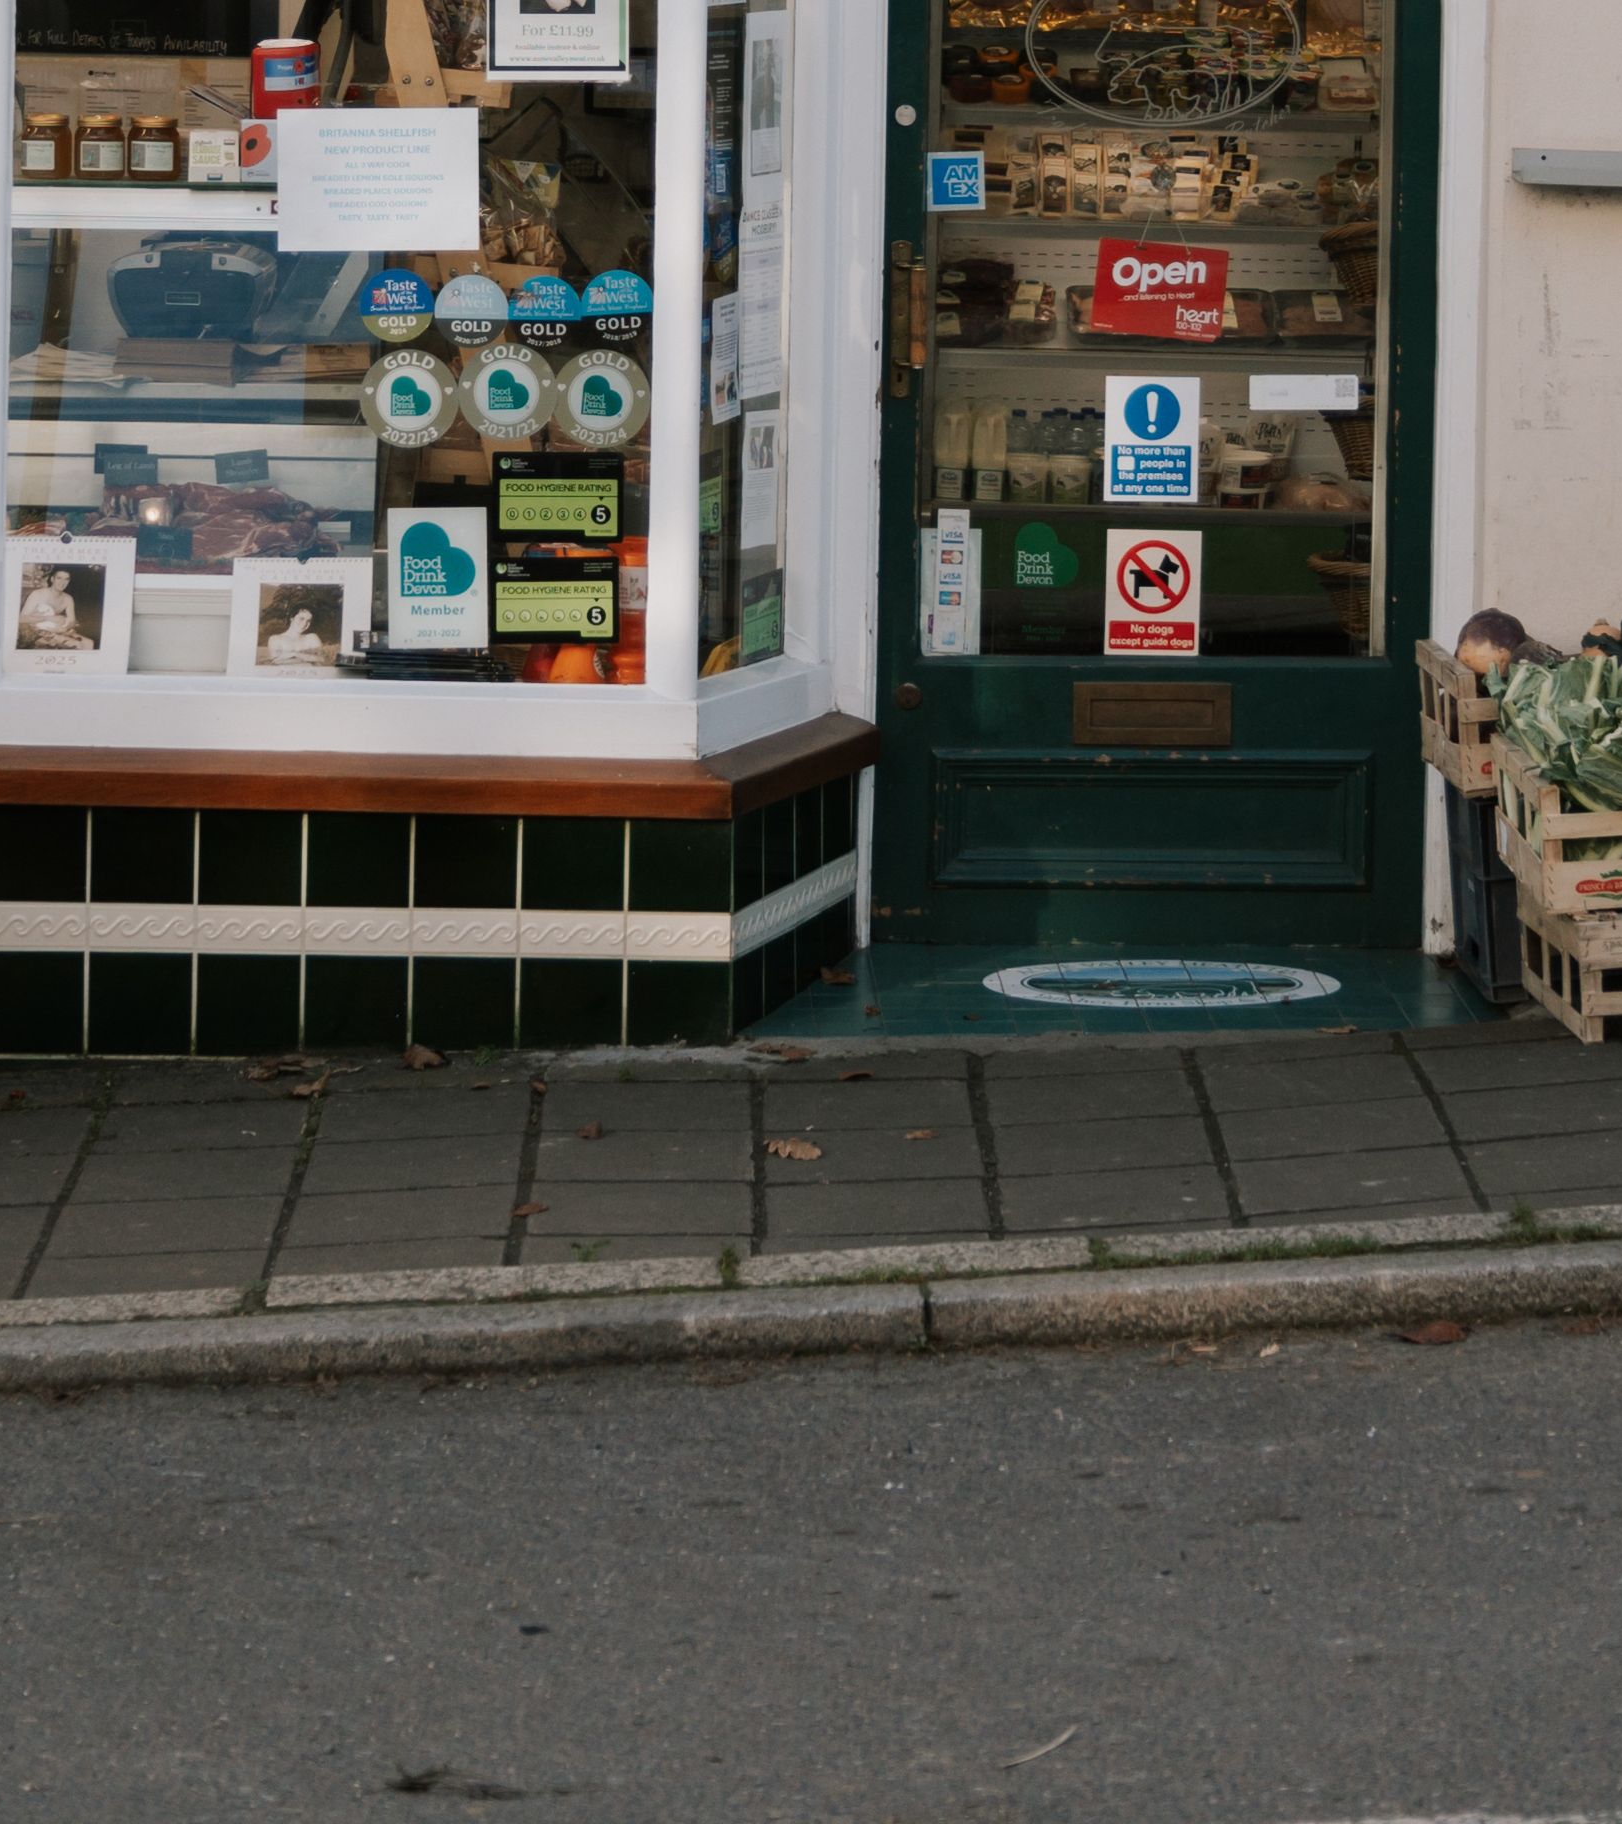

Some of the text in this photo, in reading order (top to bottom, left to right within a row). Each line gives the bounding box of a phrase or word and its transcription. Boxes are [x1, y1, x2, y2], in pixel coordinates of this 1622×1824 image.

[522, 25, 594, 37] For £11.99
[46, 31, 68, 46] FULL
[163, 35, 229, 56] AVAILABILITY
[318, 128, 436, 138] BRITANNIA SHELLFISH
[324, 145, 431, 155] NEW PRODUCT LINE
[943, 164, 979, 184] AM
[948, 182, 980, 198] EX
[1112, 257, 1207, 293] Open
[385, 279, 418, 291] Taste
[459, 280, 495, 294] Taste
[530, 282, 567, 295] Taste
[603, 276, 639, 289] Taste
[386, 293, 418, 304] West
[460, 296, 494, 309] West
[532, 297, 567, 310] West
[605, 291, 639, 304] West
[1139, 293, 1167, 302] listening
[1176, 305, 1220, 325] heart
[378, 316, 418, 327] GOLD
[451, 321, 492, 333] GOLD
[595, 316, 642, 331] GOLD
[520, 324, 567, 336] GOLD
[526, 337, 563, 348] 2017/2018
[480, 345, 532, 363] GOLD
[383, 351, 436, 371] GOLD
[578, 352, 629, 371] GOLD
[392, 393, 411, 402] Food
[489, 387, 511, 396] Food
[584, 392, 605, 402] Food
[392, 401, 416, 409] Drink
[489, 395, 514, 403] Drink
[584, 400, 607, 409] Drink
[479, 418, 537, 438] 2021/22
[381, 426, 439, 445] 2022/23
[569, 425, 628, 446] 2023/24
[1117, 446, 1185, 456] No more than
[1139, 459, 1186, 469] people in
[1118, 471, 1184, 482] the premises
[505, 483, 611, 492] FOOD HYGIENE RATING
[1112, 483, 1189, 495] at any one time
[595, 507, 607, 522] 5
[944, 531, 964, 540] VISA
[403, 555, 442, 569] Food
[1016, 550, 1050, 564] Food
[1015, 563, 1054, 575] Drink
[403, 569, 447, 582] Drink
[1015, 575, 1054, 585] Devon
[403, 582, 447, 595] Devon
[502, 586, 607, 595] FOOD HYGIENE RATING
[411, 604, 466, 616] Member
[591, 608, 602, 624] 5
[416, 629, 461, 638] 2021-2022
[1130, 624, 1174, 636] No dogs
[1110, 636, 1193, 649] except guide dogs
[34, 656, 78, 666] 2025
